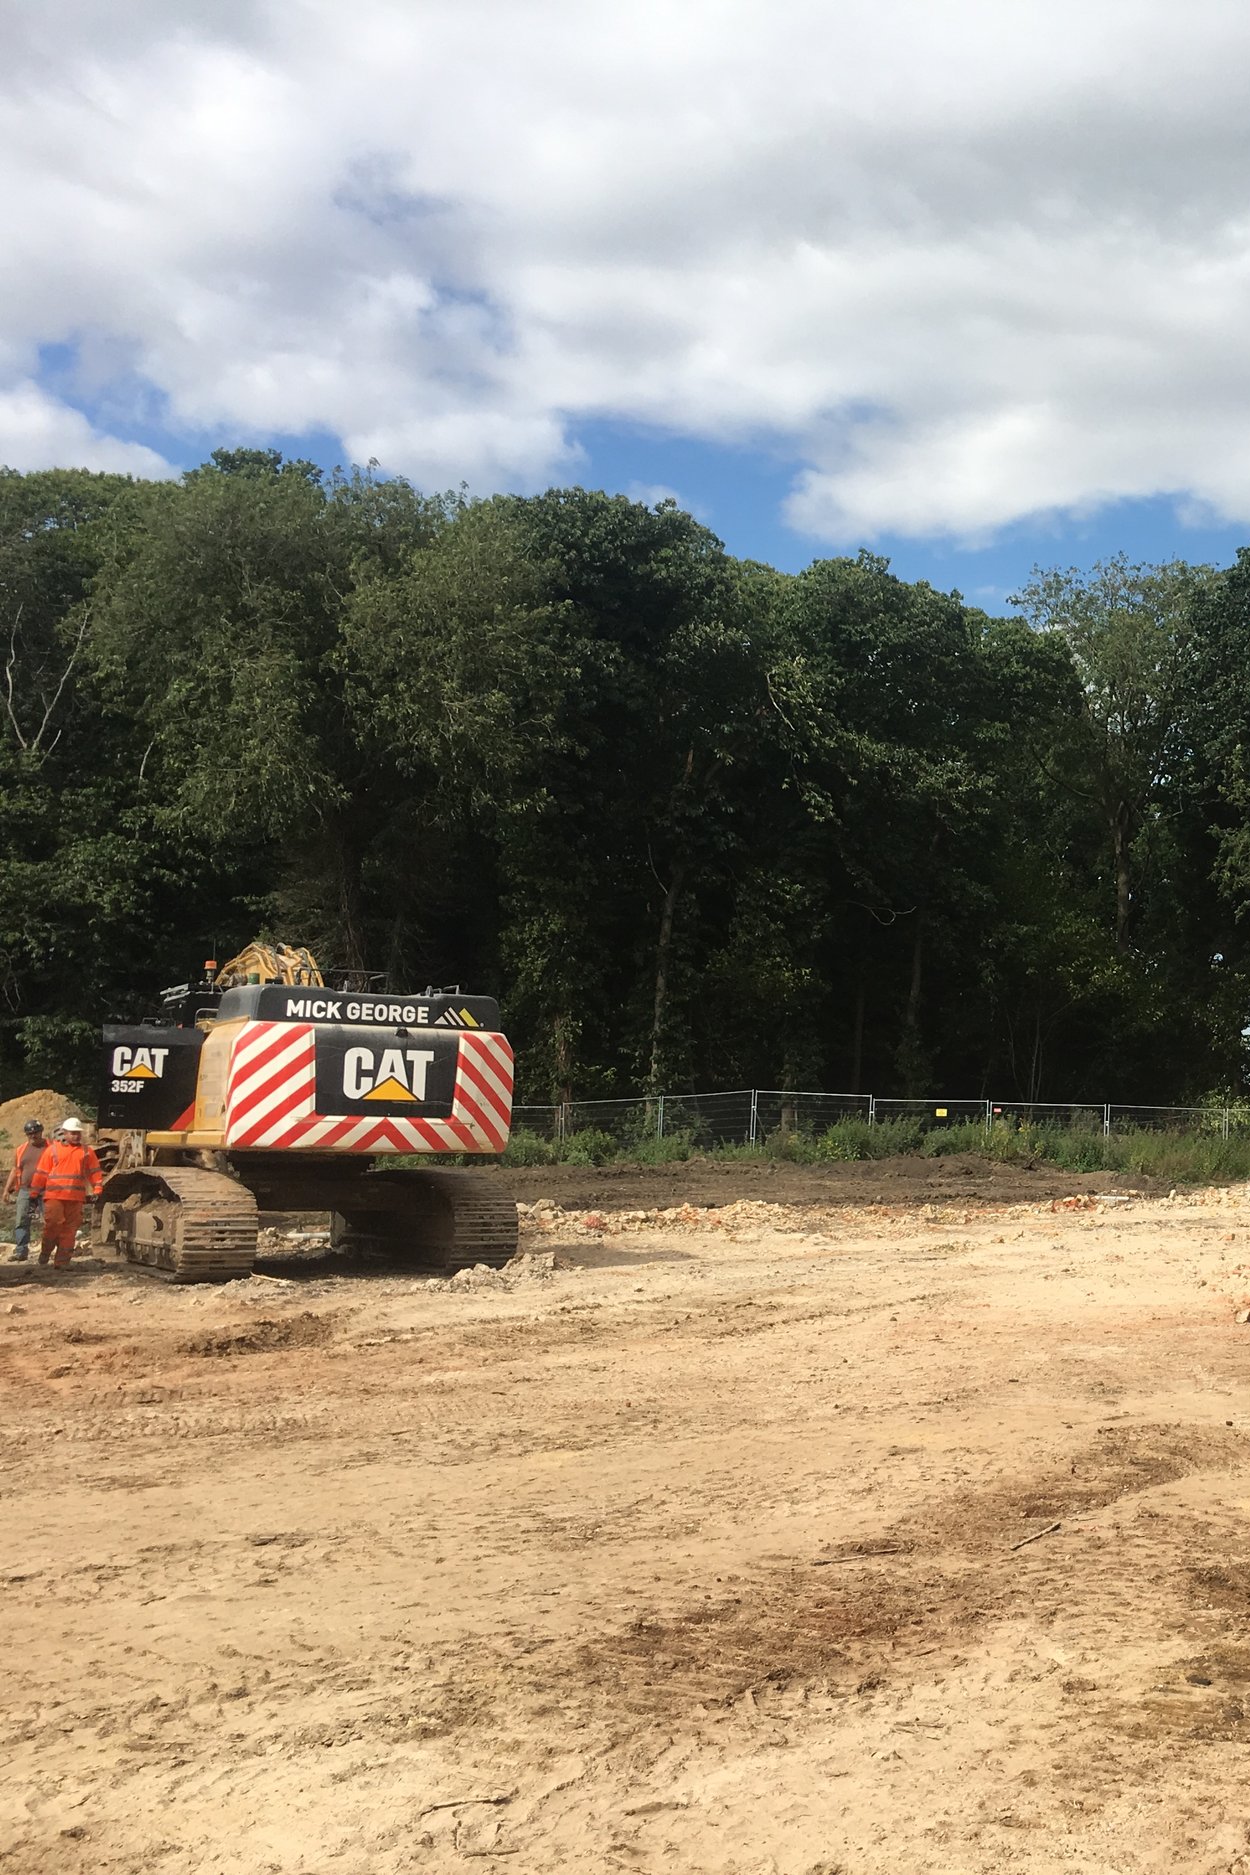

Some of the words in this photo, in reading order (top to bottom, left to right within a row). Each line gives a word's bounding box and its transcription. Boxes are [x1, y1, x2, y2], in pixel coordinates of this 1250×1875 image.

[286, 999, 342, 1019] MICK
[346, 1002, 429, 1023] GEORGE
[112, 1046, 169, 1078] CAT
[342, 1046, 435, 1101] CAT
[111, 1079, 145, 1093] 352F
